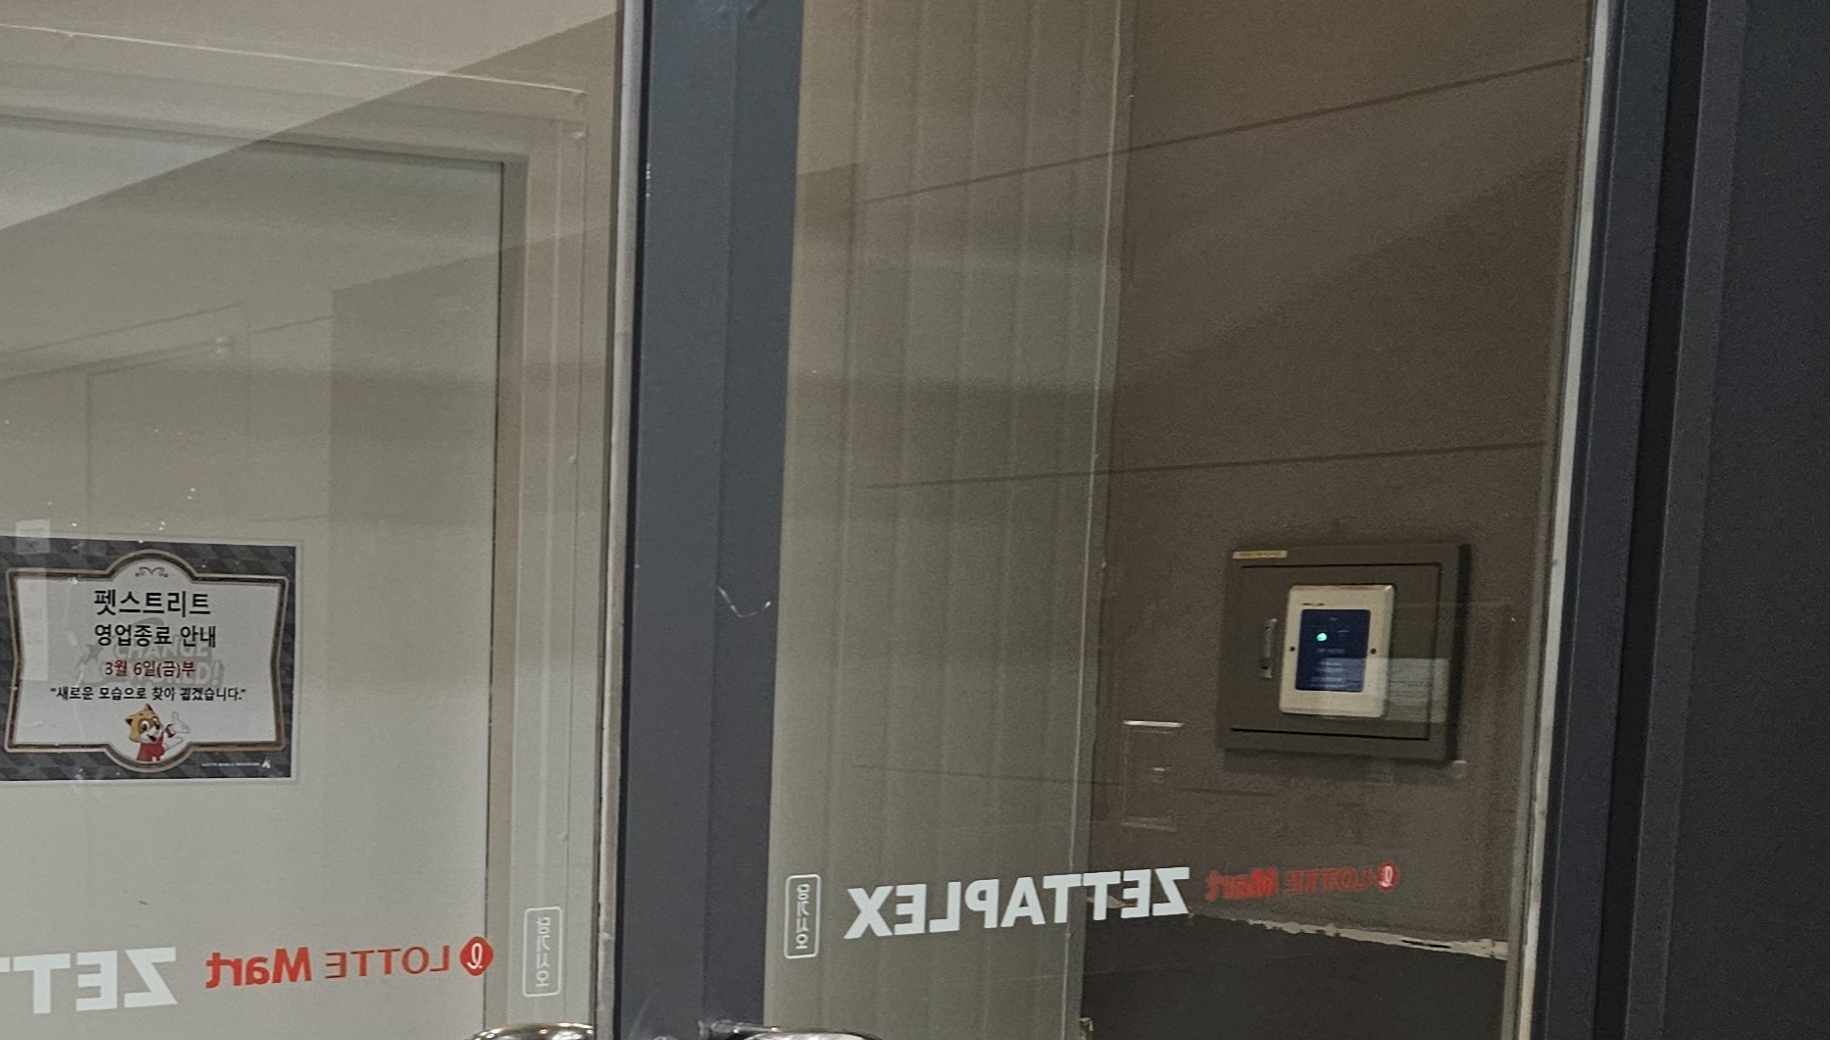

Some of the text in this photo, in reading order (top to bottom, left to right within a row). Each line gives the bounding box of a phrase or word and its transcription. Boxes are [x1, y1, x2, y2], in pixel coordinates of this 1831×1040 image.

[94, 589, 211, 617] 펫스트리트
[95, 624, 215, 648] 영업종료 안내
[104, 659, 196, 678] 3월 6일(금)부
[99, 687, 147, 700] 모습으로
[152, 687, 175, 701] 찾아
